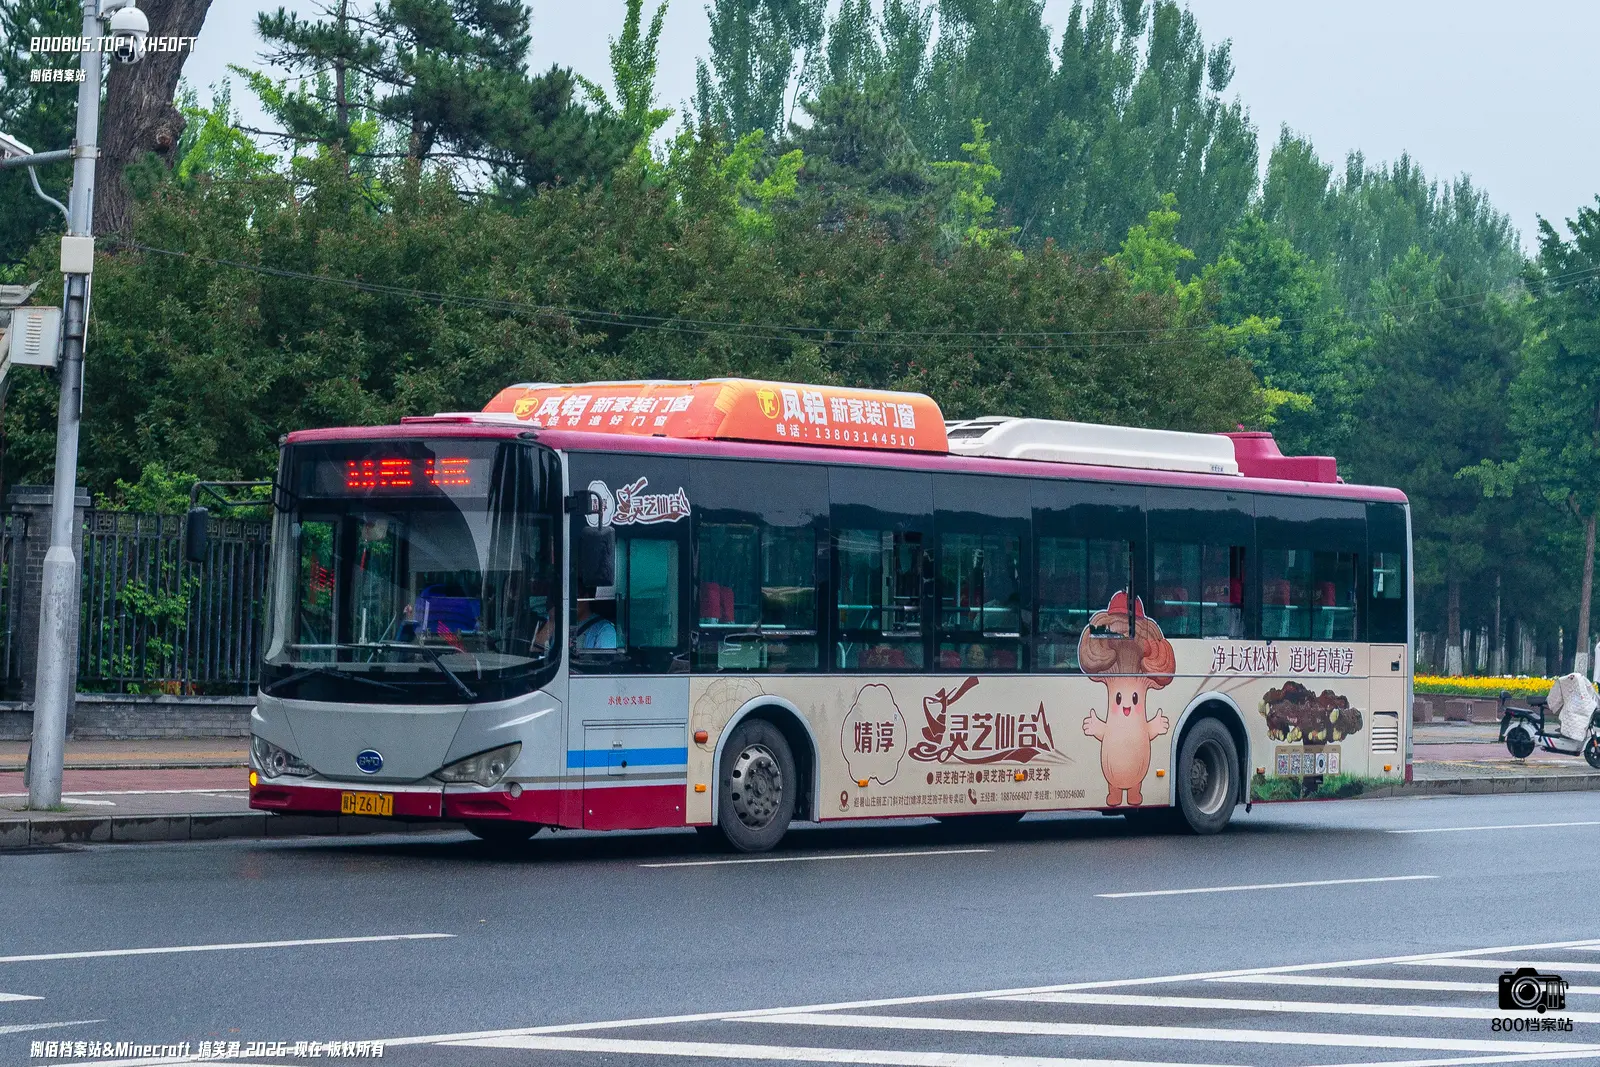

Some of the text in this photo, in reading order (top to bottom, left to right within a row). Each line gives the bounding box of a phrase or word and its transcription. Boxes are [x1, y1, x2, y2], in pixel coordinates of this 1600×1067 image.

[590, 395, 695, 413] 新家装门窗
[780, 388, 916, 429] 凤铝 新家装门窗
[1211, 645, 1354, 676] 净土沃松林 道地育婧淳
[608, 696, 652, 705] 承德公交集团
[853, 721, 895, 754] 婧淳
[949, 701, 1055, 752] 灵芝仙谷
[359, 756, 380, 766] BYD
[934, 771, 975, 785] 灵芝孢子油
[1027, 767, 1051, 782] 灵芝茶
